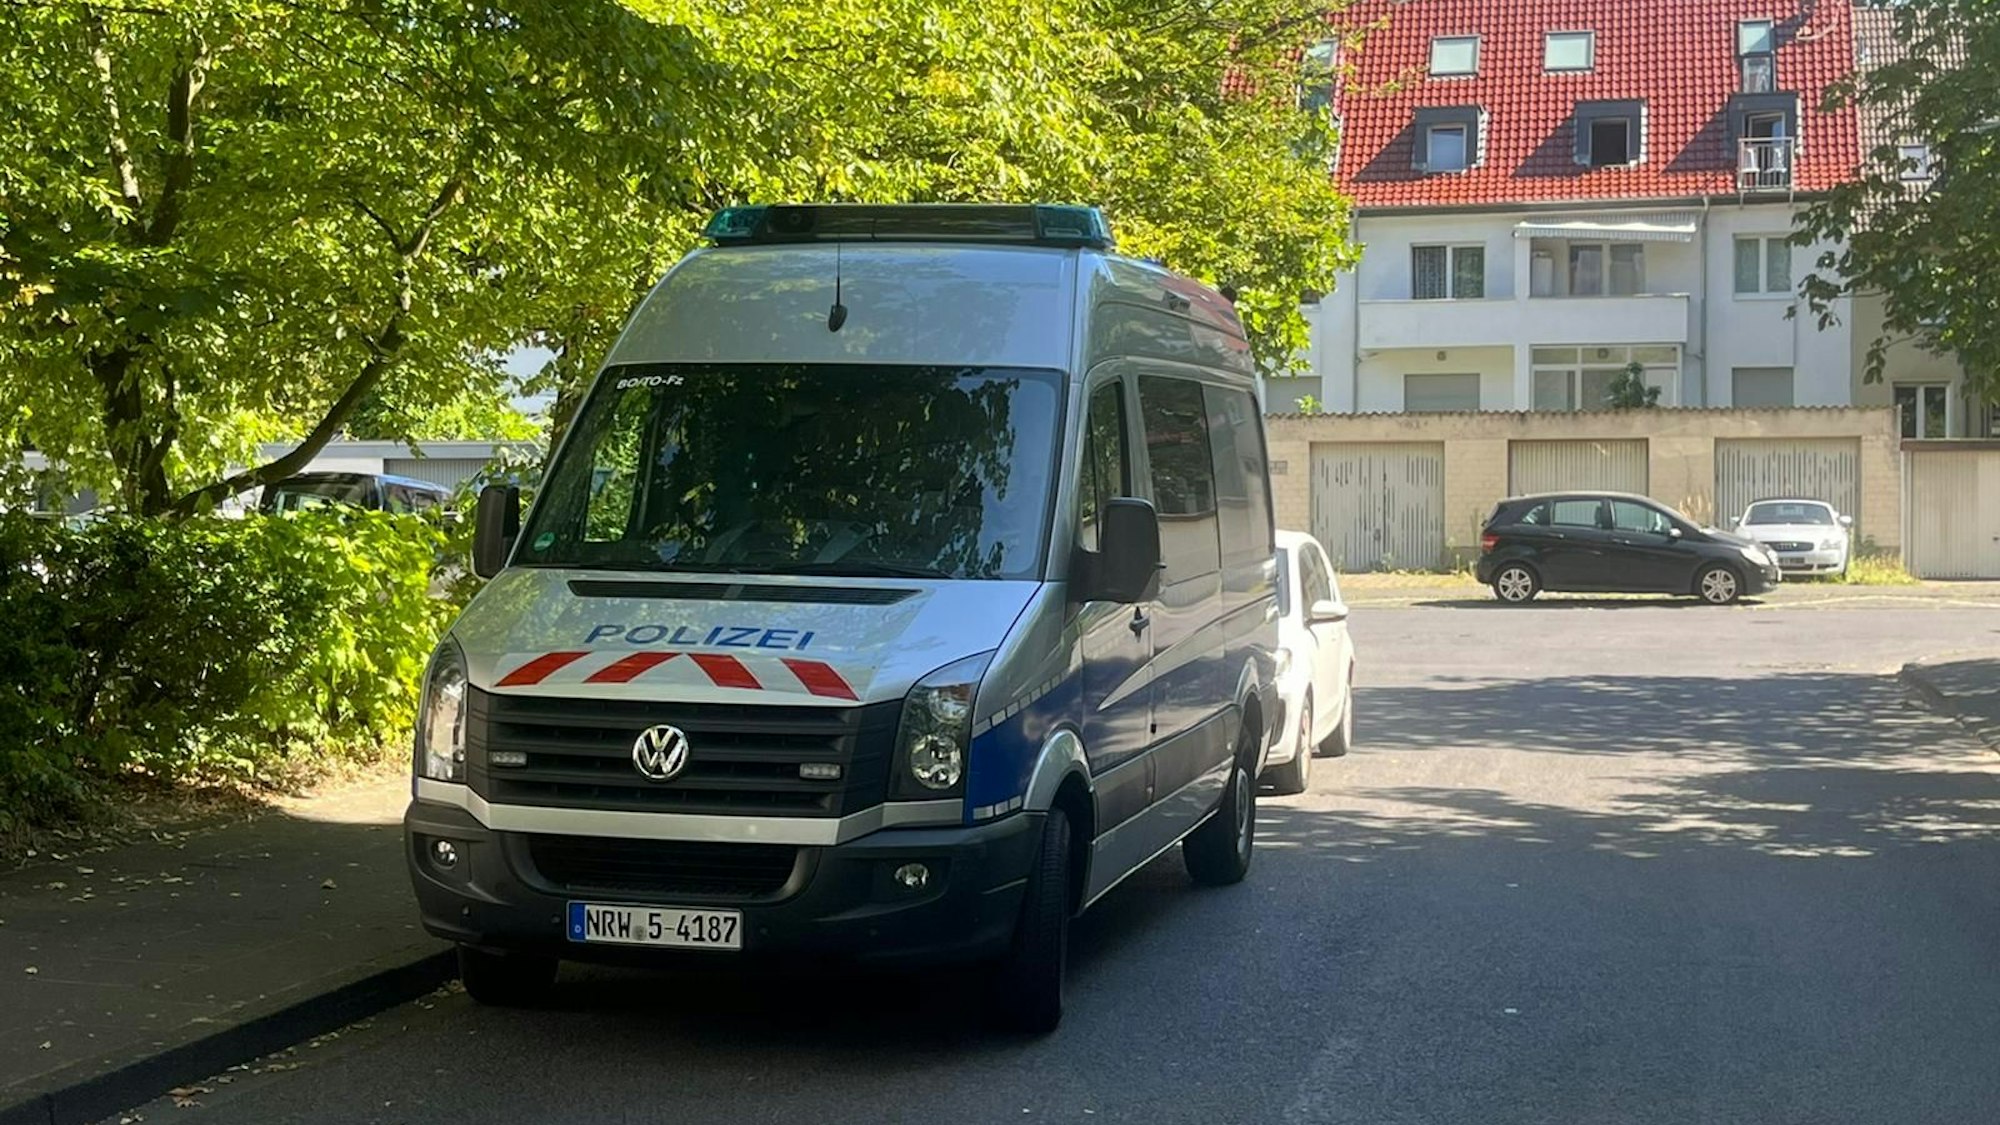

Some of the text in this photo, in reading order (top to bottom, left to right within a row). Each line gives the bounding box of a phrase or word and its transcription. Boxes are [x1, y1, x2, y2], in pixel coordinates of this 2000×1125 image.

[584, 624, 815, 650] POLIZEI
[632, 724, 689, 779] VW
[586, 908, 737, 943] NRW 5-4187
